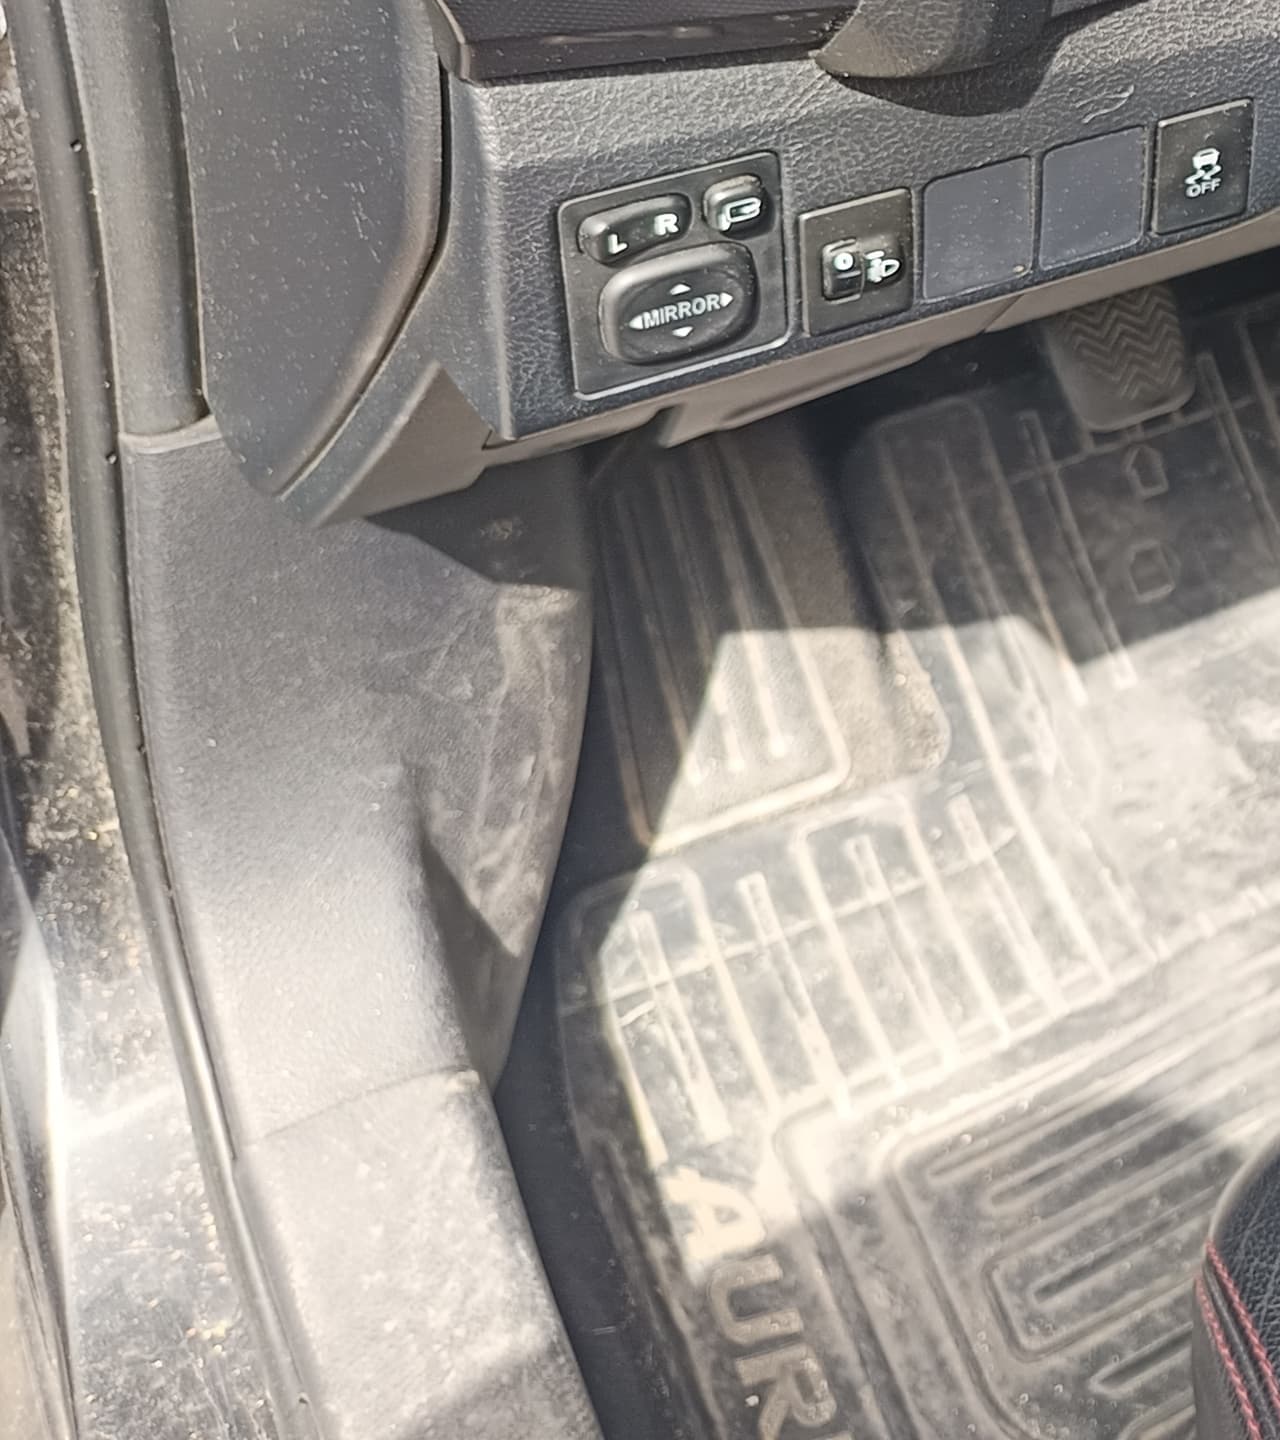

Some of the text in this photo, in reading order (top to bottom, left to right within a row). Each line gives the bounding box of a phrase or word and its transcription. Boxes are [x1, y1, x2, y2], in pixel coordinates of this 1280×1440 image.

[1186, 178, 1221, 198] OFF
[608, 213, 679, 254] L R
[644, 293, 720, 329] MIRROR
[663, 1164, 856, 1440] AUR
